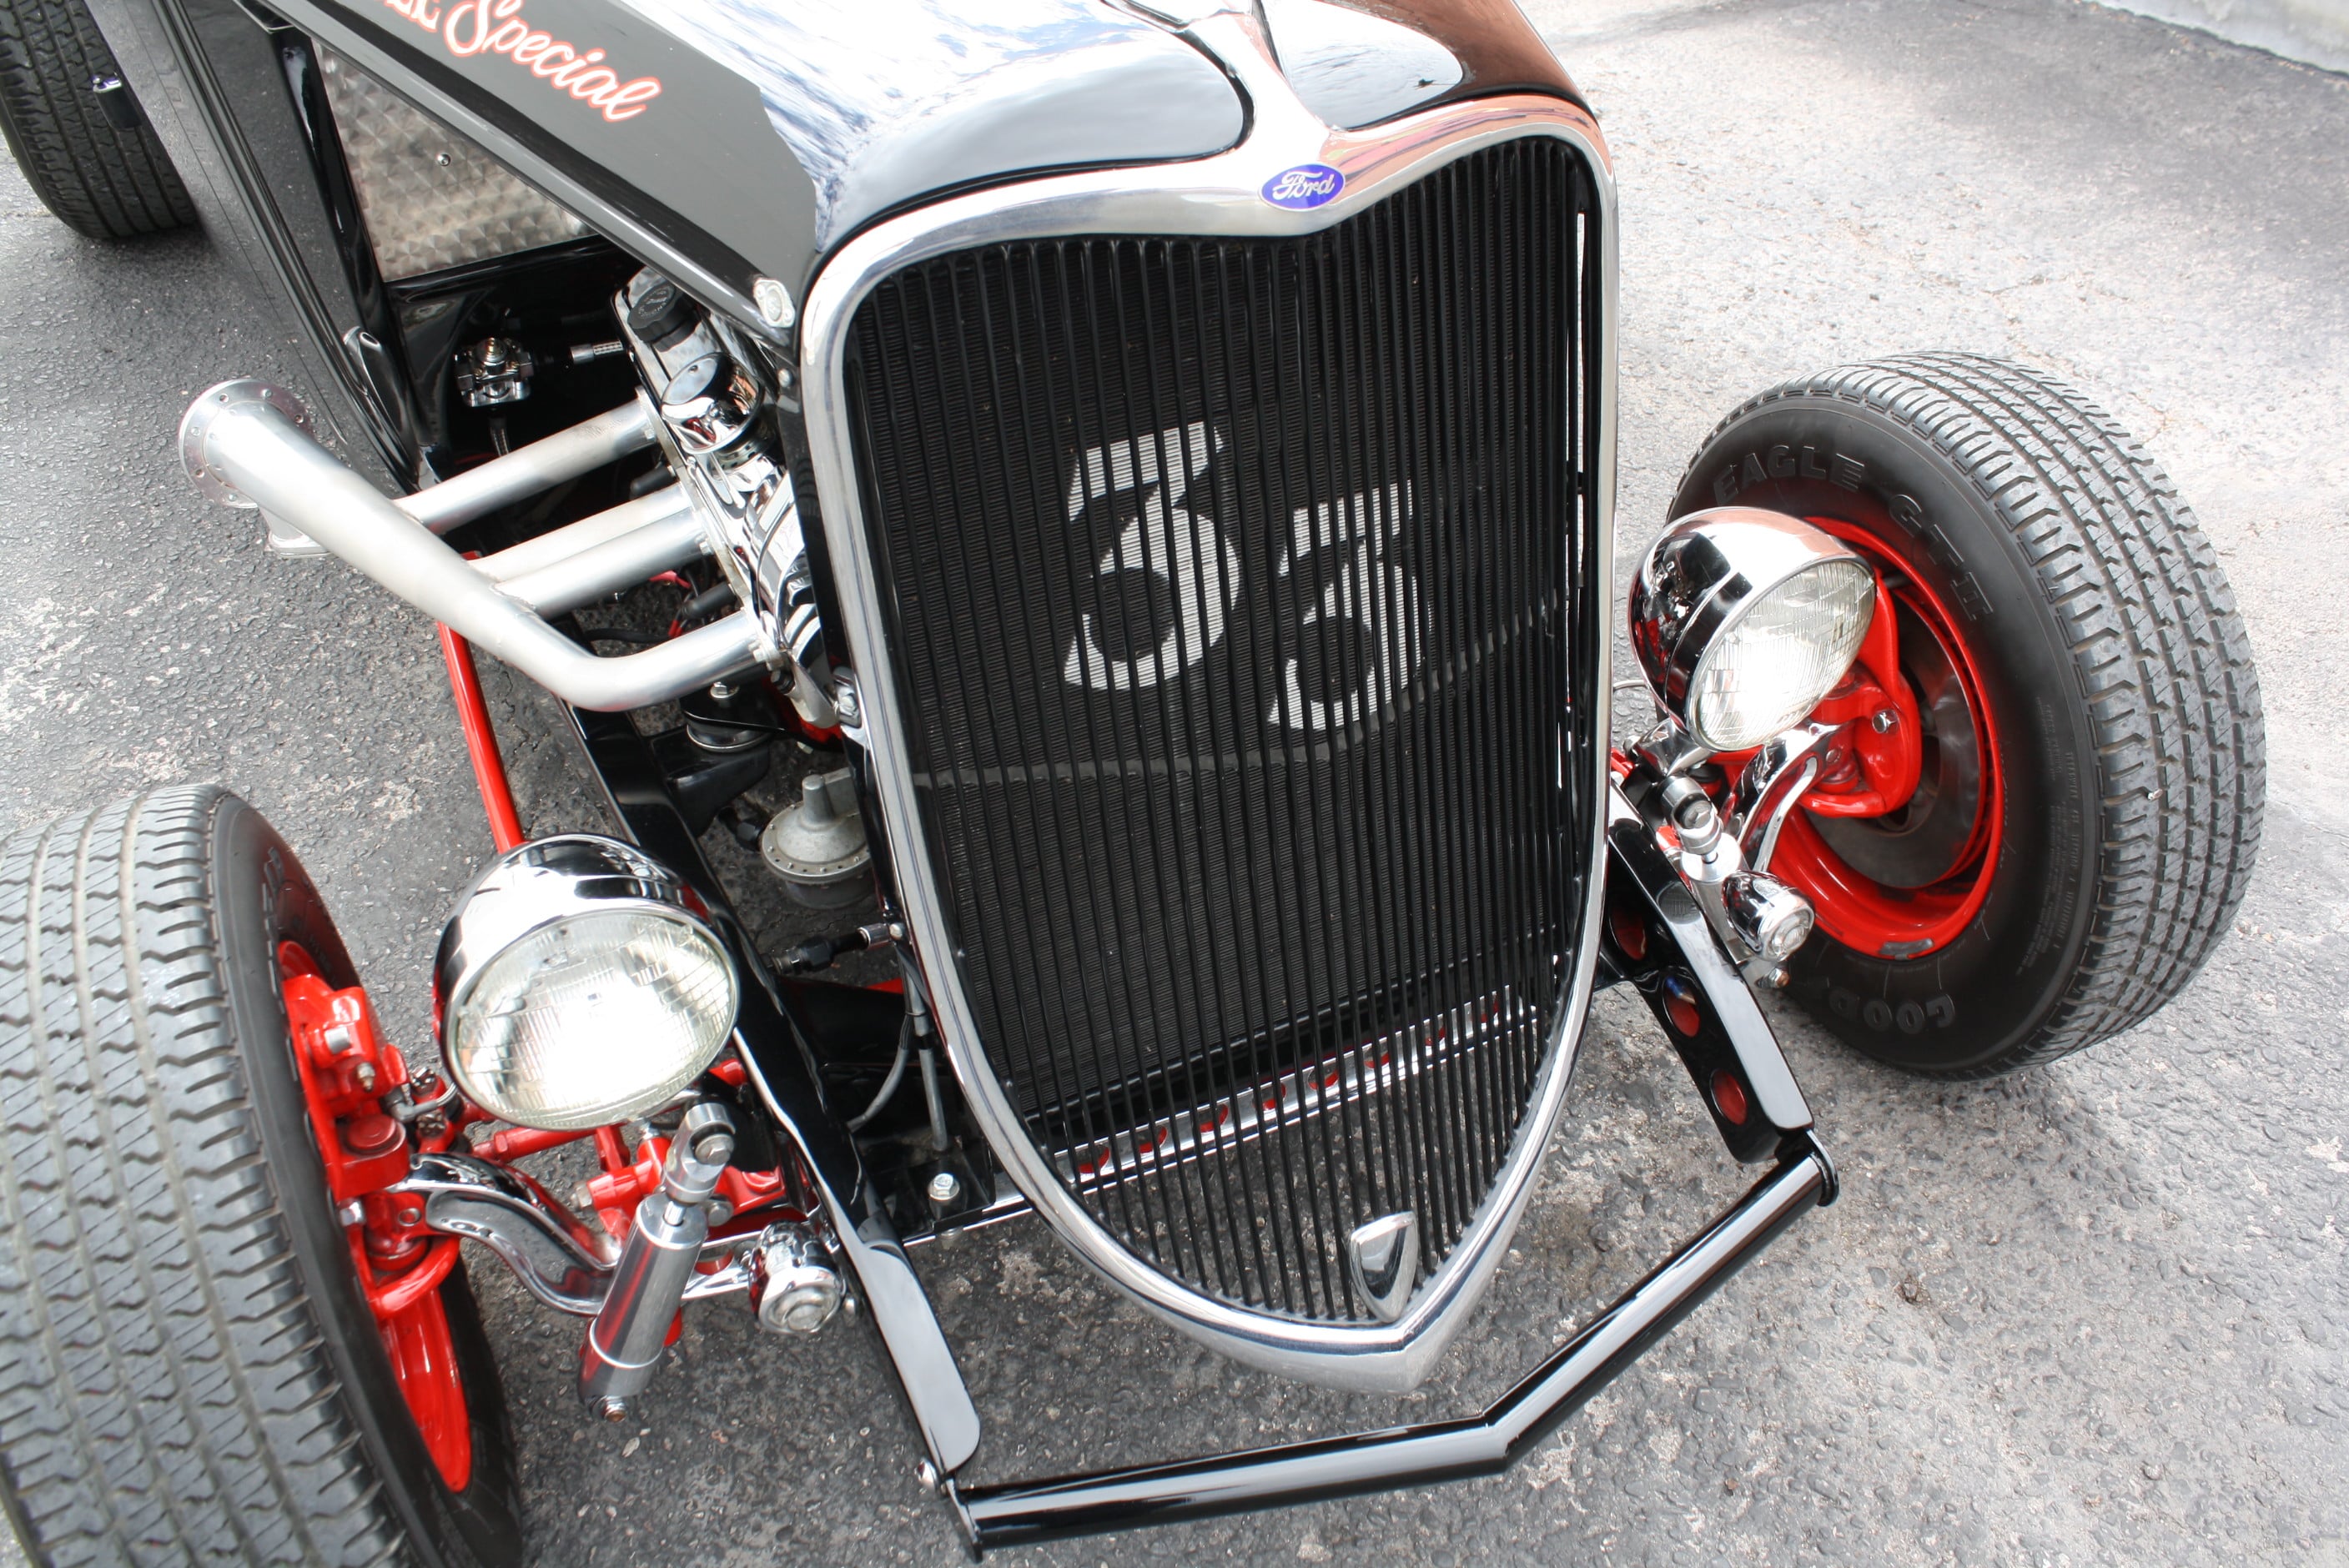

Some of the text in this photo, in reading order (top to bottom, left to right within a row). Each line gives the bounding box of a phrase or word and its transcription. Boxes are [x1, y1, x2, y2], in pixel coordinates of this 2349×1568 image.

[445, 0, 661, 122] Special
[1272, 170, 1335, 200] Ford
[1713, 445, 1865, 505] EAGLE
